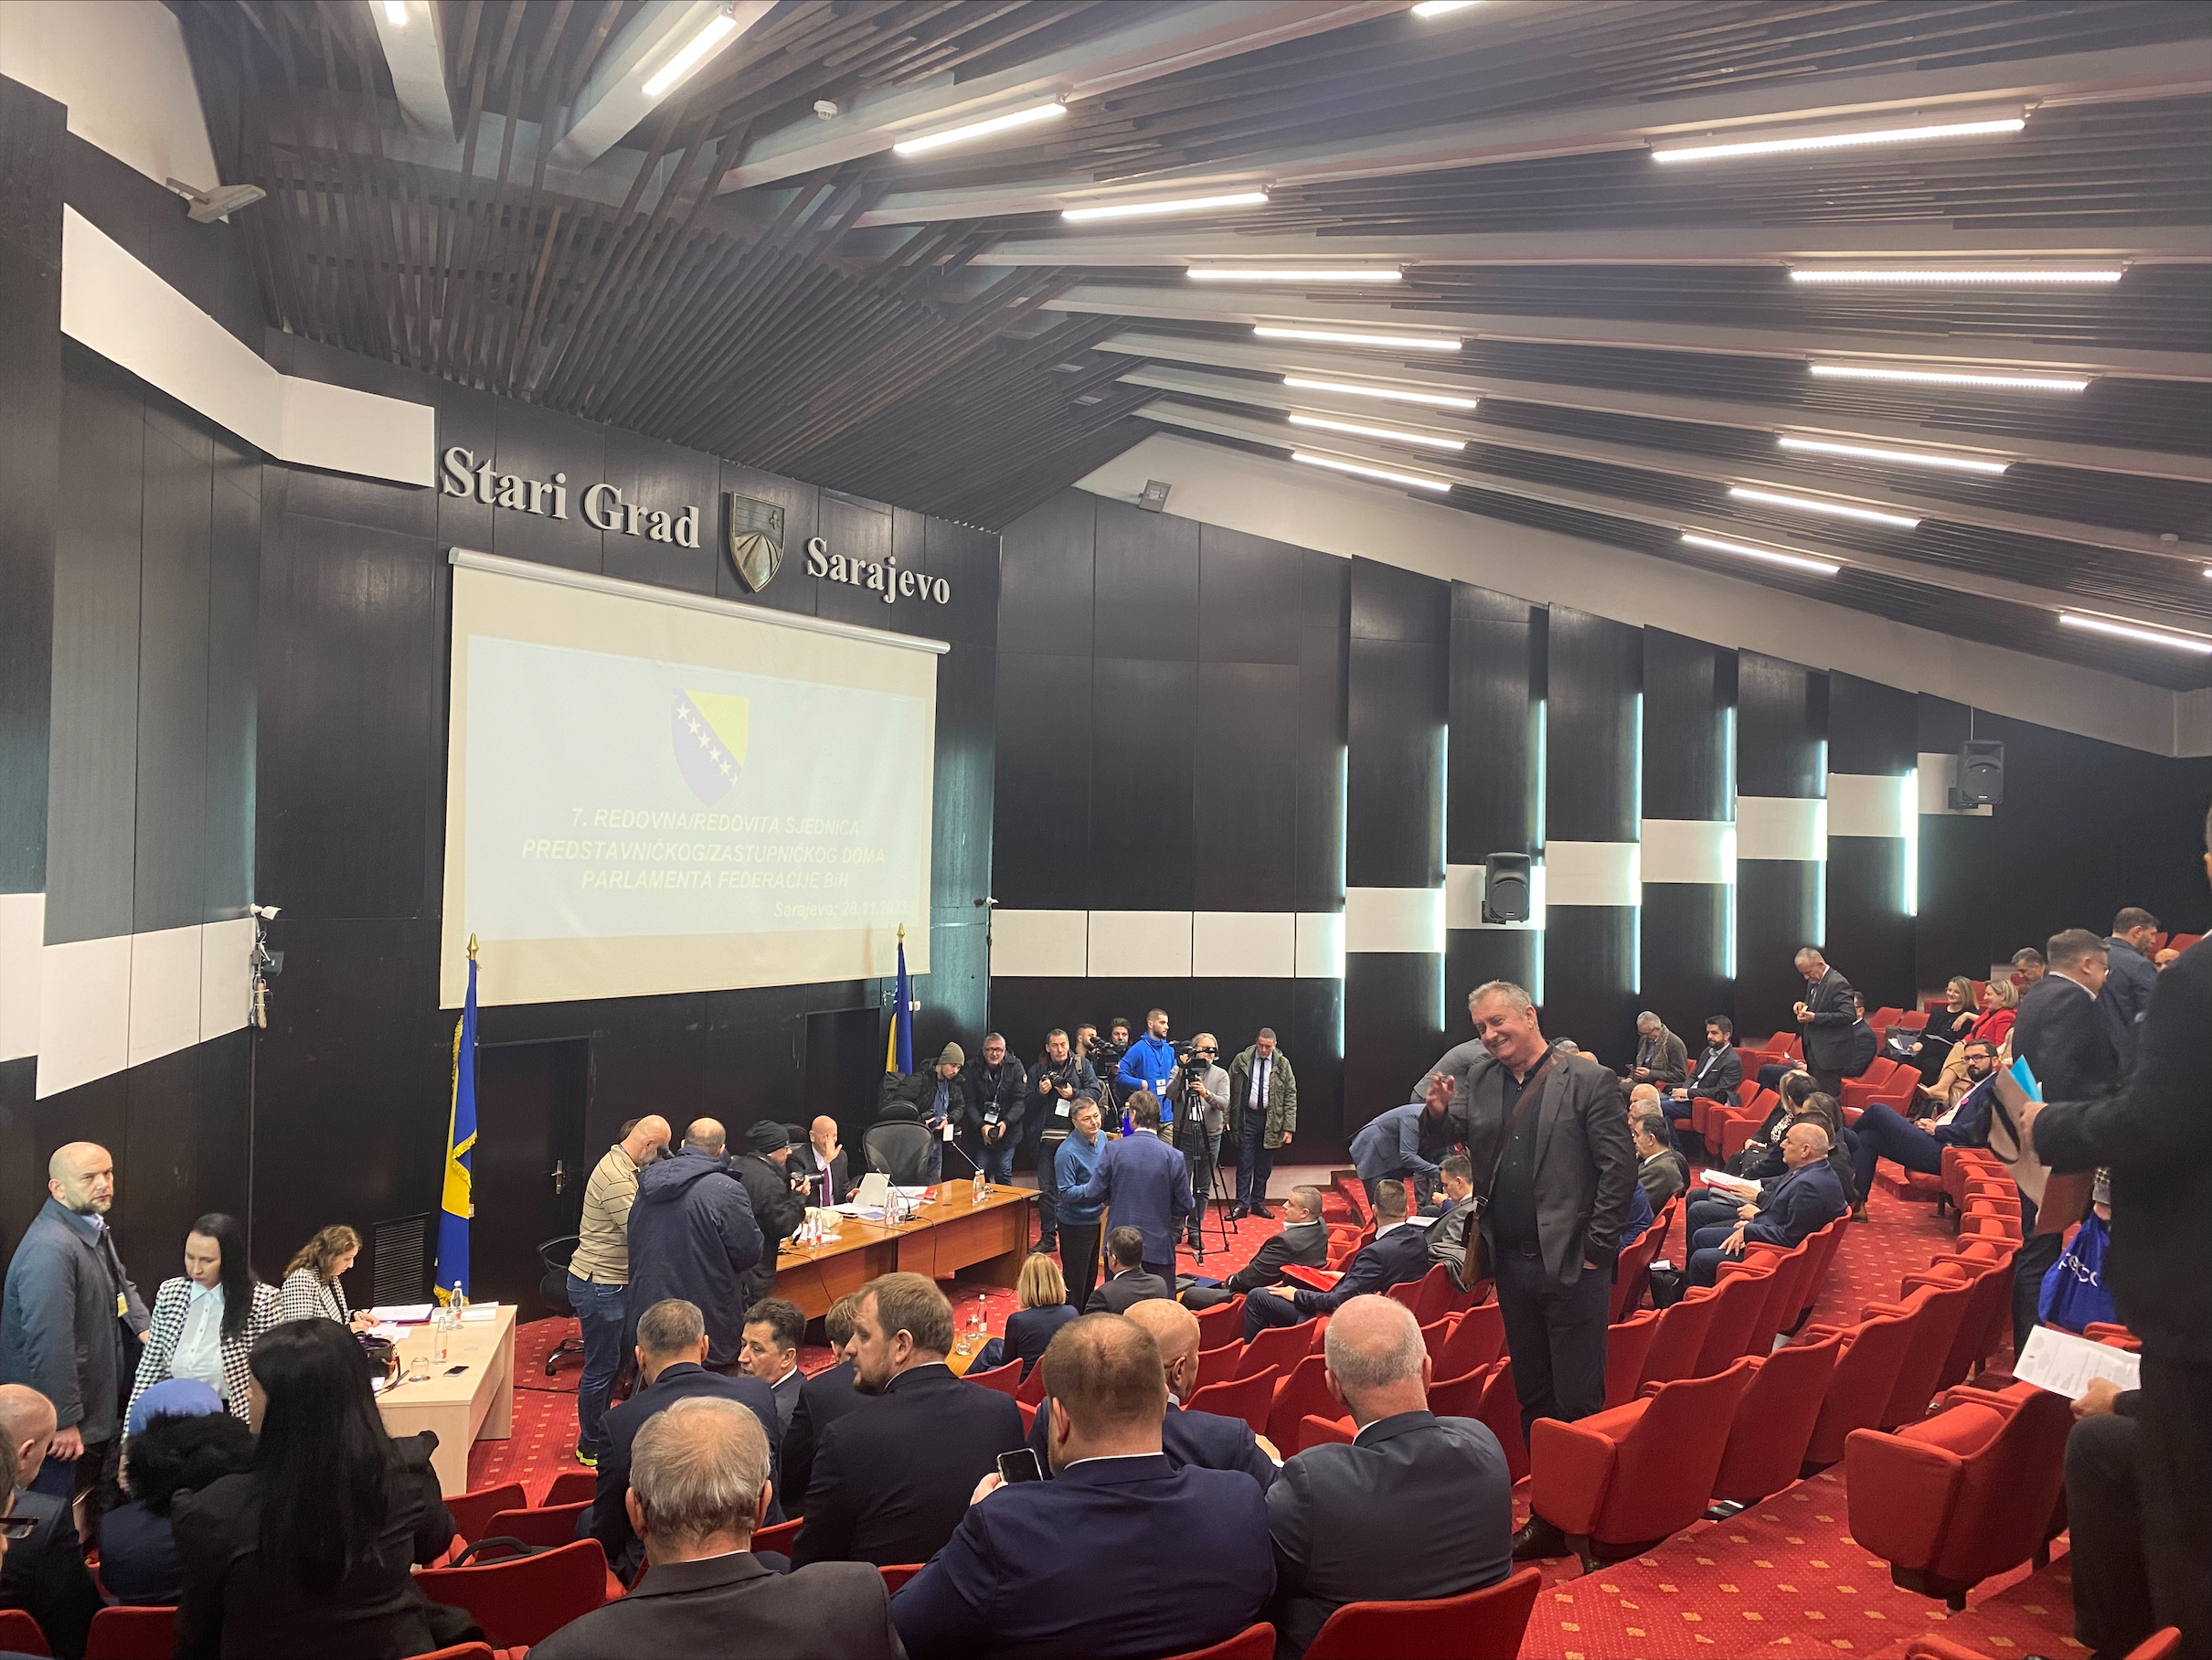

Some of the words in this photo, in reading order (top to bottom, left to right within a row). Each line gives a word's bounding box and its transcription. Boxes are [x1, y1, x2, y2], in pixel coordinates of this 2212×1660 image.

[443, 446, 569, 520] Stari
[584, 483, 701, 548] Grad
[807, 537, 951, 605] Sarajevo
[571, 806, 587, 827] 7.
[593, 808, 780, 834] REDOVNA/REDOVITA
[784, 815, 859, 836] SJEDNICA
[521, 838, 838, 864] PREDSTAVNIČKOG/ZASTUPNIČKOG
[841, 846, 886, 865] DOMA
[581, 869, 713, 889] PARLAMENTA
[717, 870, 821, 889] FEDERACIJE
[823, 871, 850, 889] BiH
[773, 900, 839, 920] Sarajevo:
